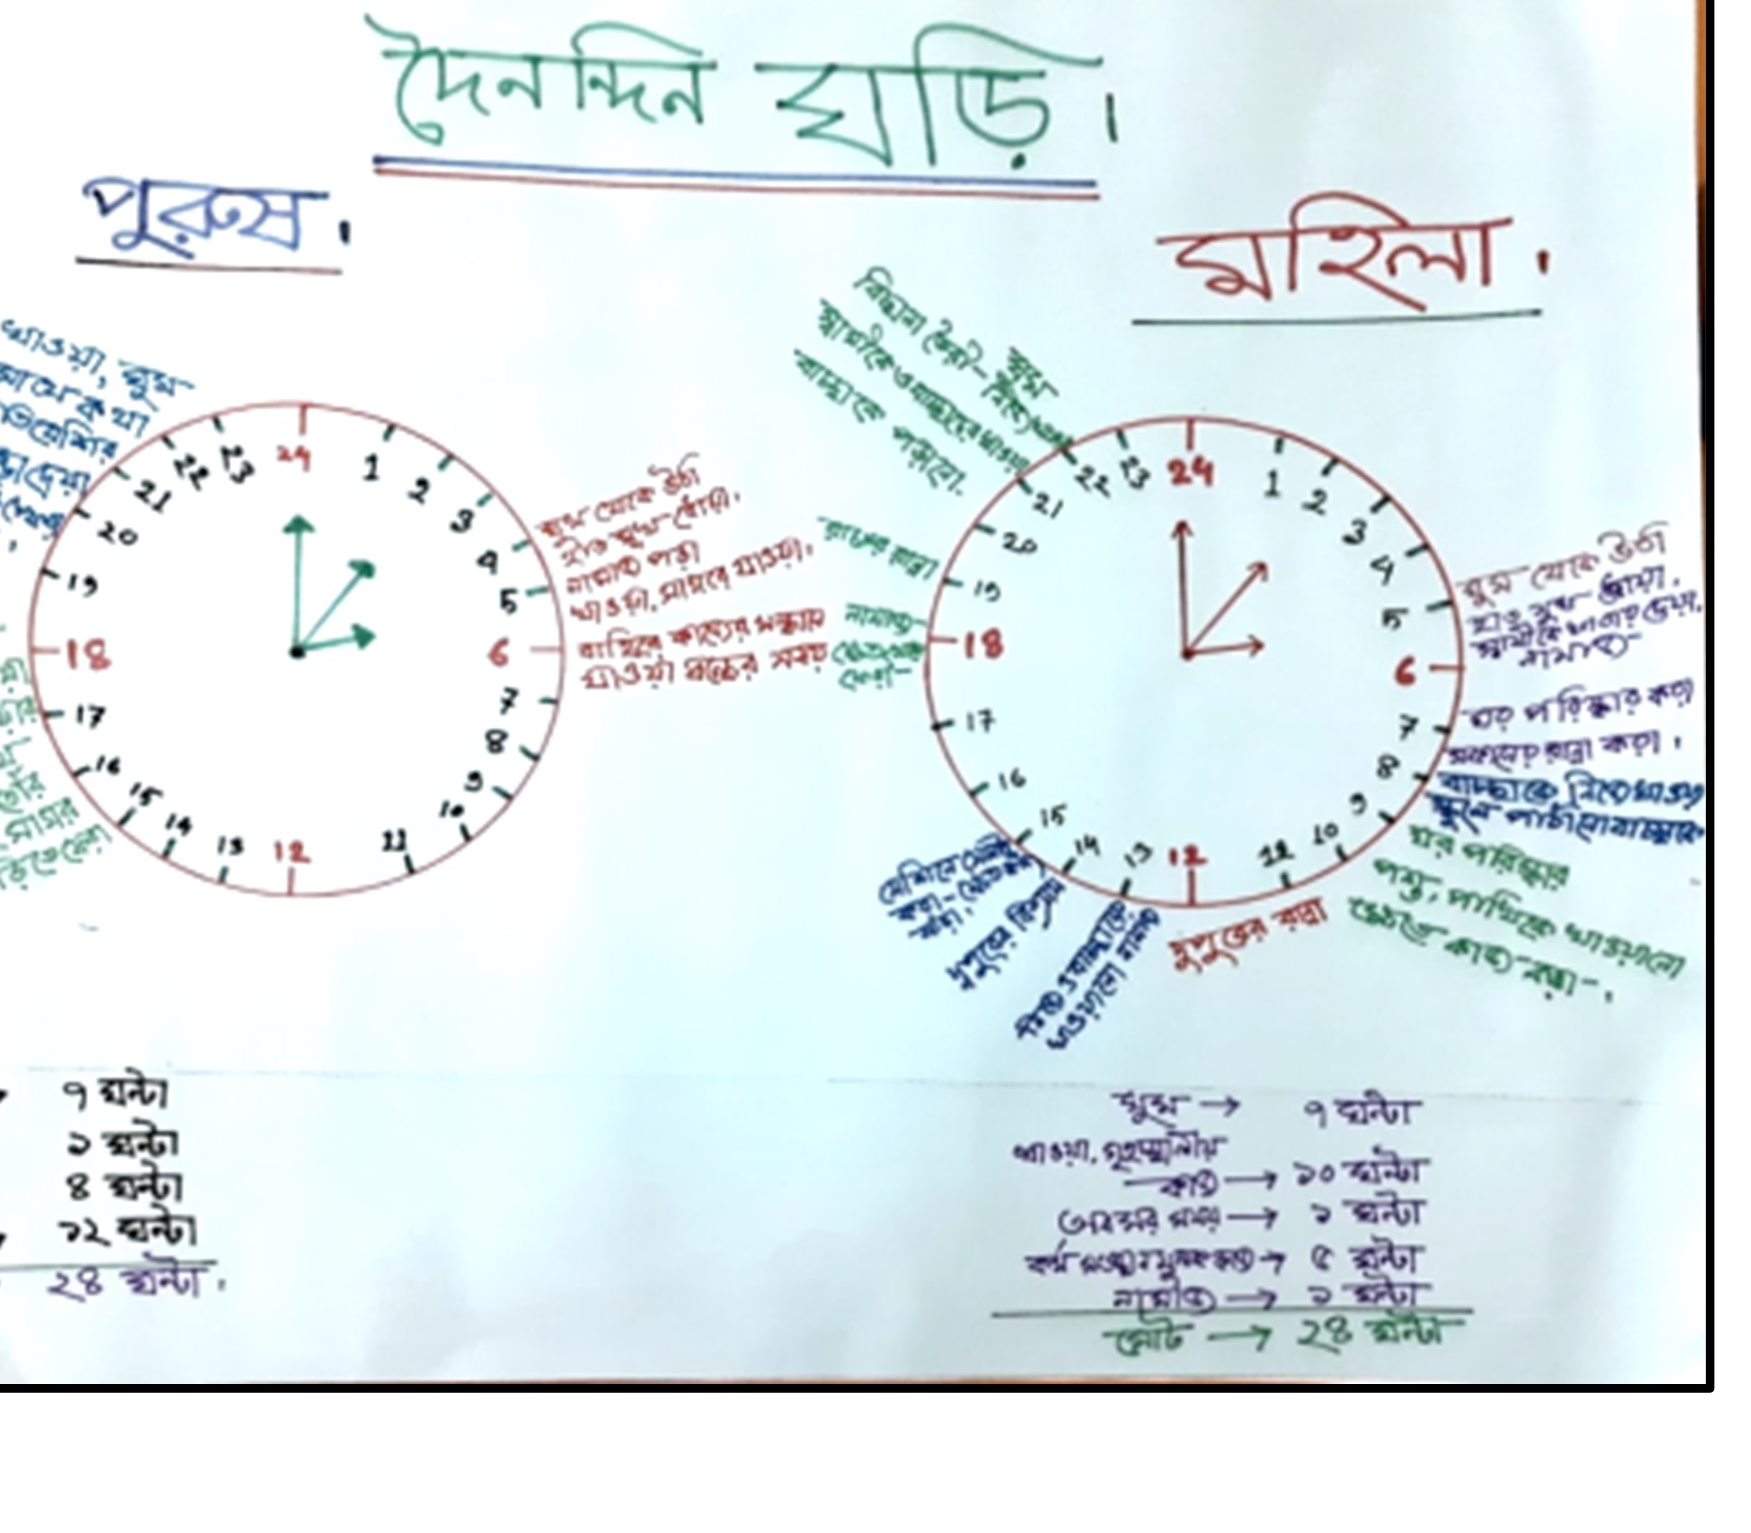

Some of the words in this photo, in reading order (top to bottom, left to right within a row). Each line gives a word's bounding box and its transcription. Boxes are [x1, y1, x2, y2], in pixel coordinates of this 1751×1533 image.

[219, 444, 256, 485] 23
[276, 444, 312, 472] 24
[362, 452, 380, 482] 1
[1166, 454, 1215, 487] 24
[172, 453, 211, 492] 22
[1073, 464, 1111, 499] 22
[1119, 455, 1151, 491] 23
[1264, 468, 1281, 499] 1
[133, 478, 173, 514] 21
[406, 476, 431, 506] 2
[1301, 488, 1328, 516] 2
[1032, 491, 1064, 520] 21
[96, 520, 139, 547] 20
[448, 507, 476, 534] 3
[1341, 518, 1368, 546] 3
[1002, 531, 1039, 555] 20
[475, 548, 499, 576] 4
[1369, 554, 1395, 587] 4
[499, 587, 519, 616] 5
[1381, 607, 1410, 631] 5
[66, 637, 112, 672] 18
[487, 637, 510, 668] 6
[964, 627, 1004, 660] 18
[1394, 655, 1416, 687] 6
[499, 685, 520, 716] 7
[75, 703, 107, 730] 17
[966, 707, 996, 734] 17
[1399, 713, 1420, 741] 7
[484, 727, 510, 756] 8
[94, 754, 121, 776] 16
[998, 767, 1027, 791] 16
[1375, 753, 1401, 780] 8
[129, 781, 164, 808] 15
[463, 769, 484, 794] 9
[1040, 803, 1068, 828] 15
[1349, 791, 1368, 816] 9
[274, 839, 312, 864] 12
[1169, 845, 1206, 866] 12
